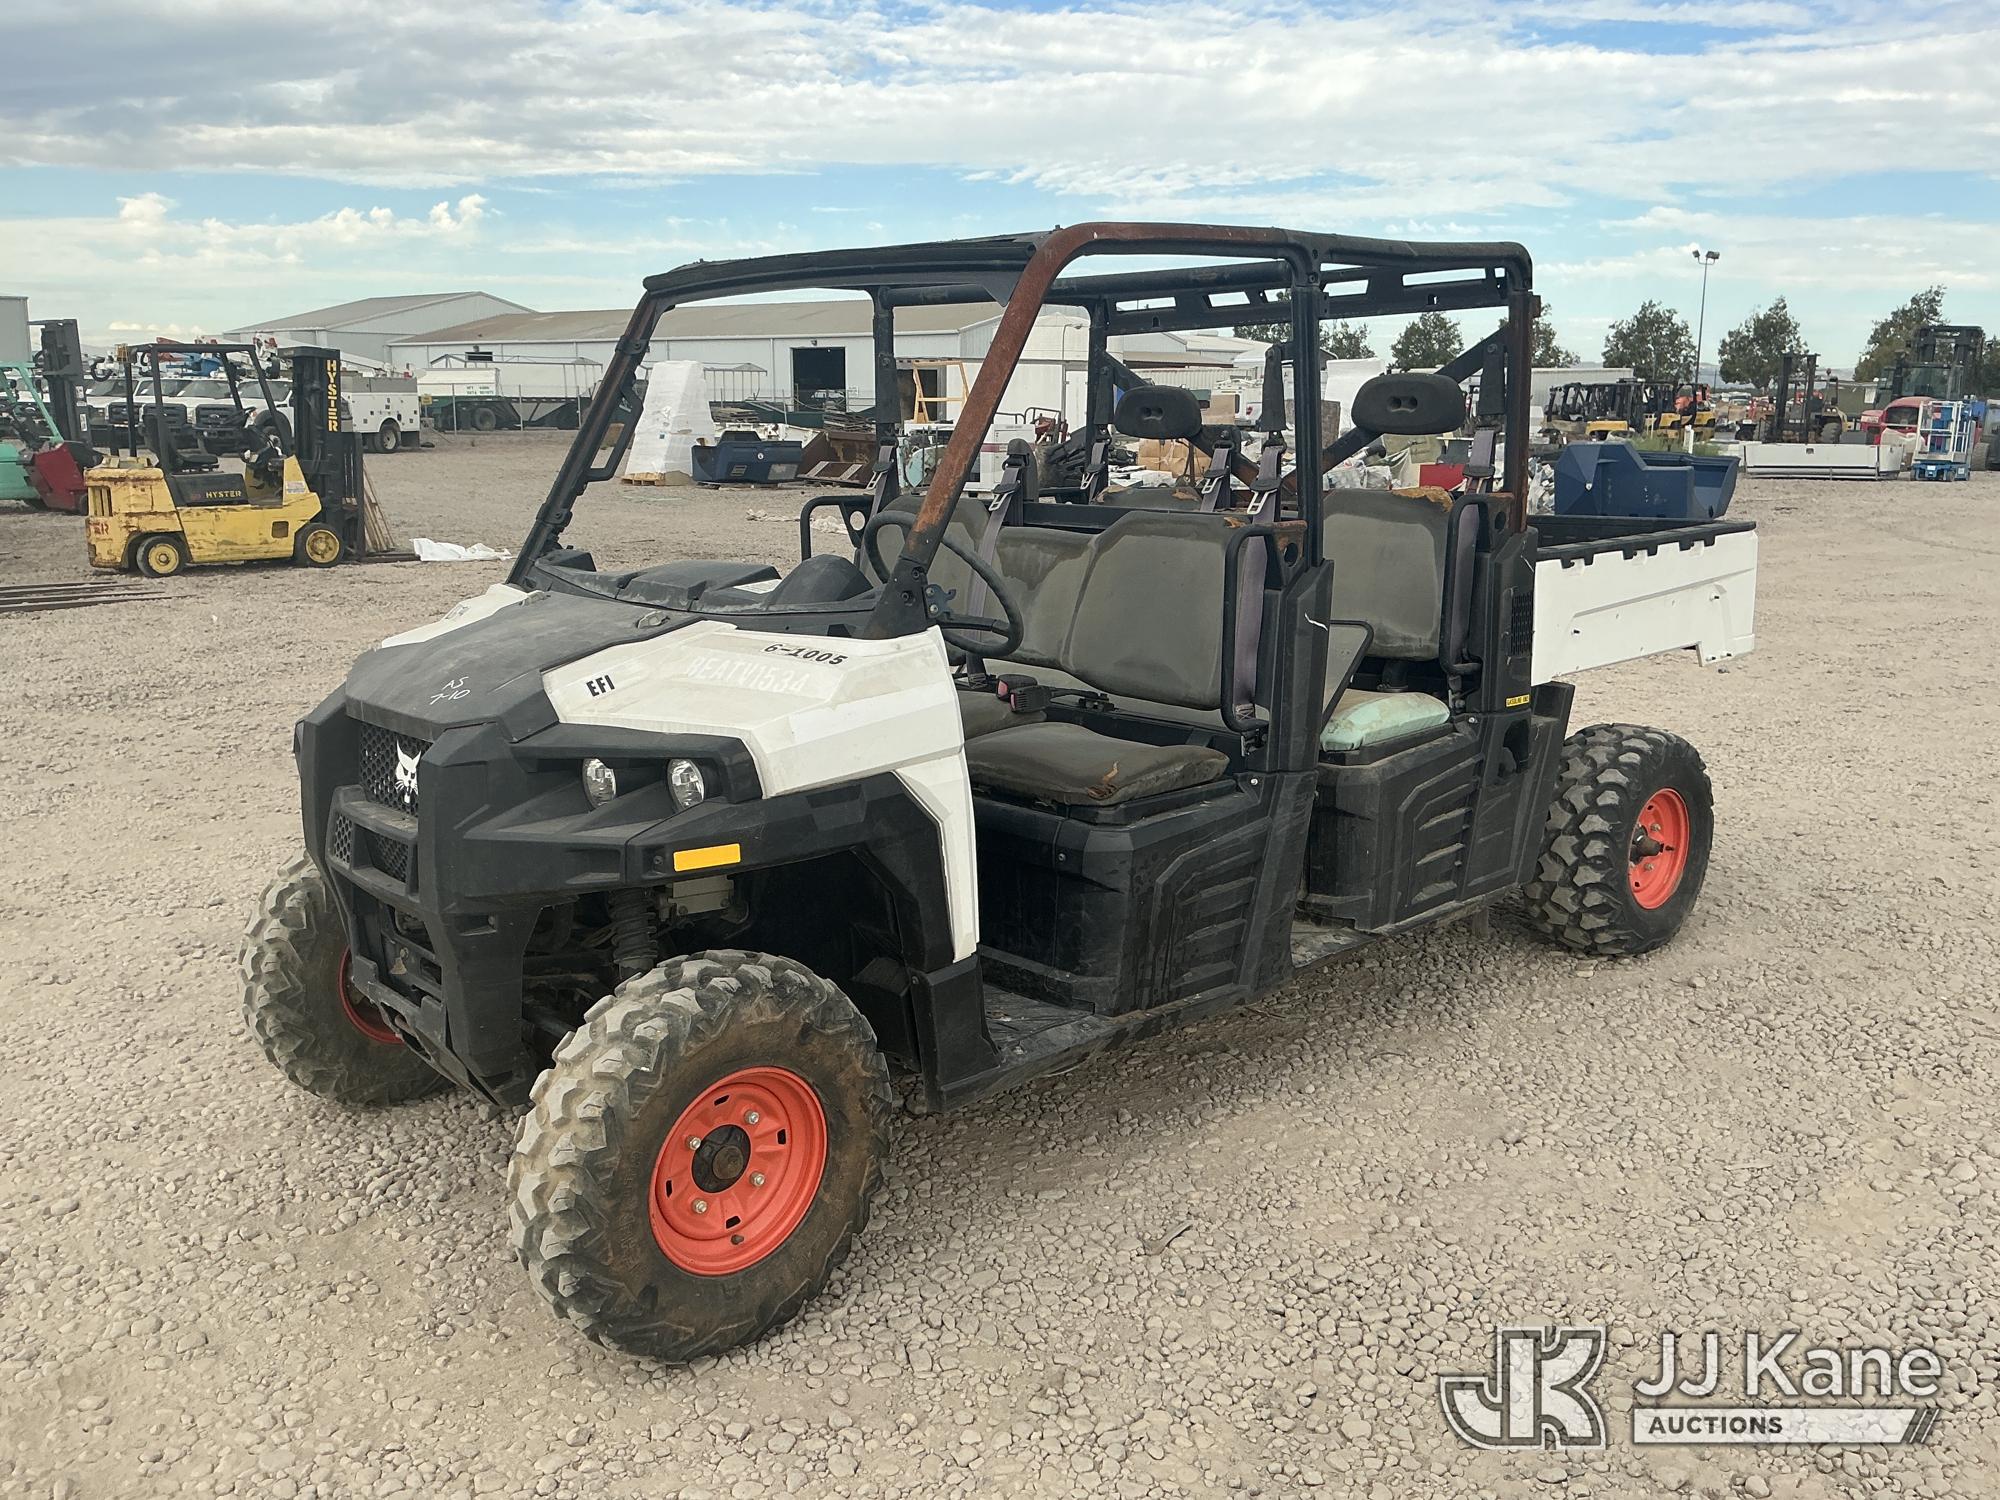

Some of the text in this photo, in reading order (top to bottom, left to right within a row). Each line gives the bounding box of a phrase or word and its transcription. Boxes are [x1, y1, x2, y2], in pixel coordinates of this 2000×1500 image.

[326, 359, 338, 432] HYSTER
[205, 490, 242, 499] HYSTER
[764, 643, 848, 665] 6-1005
[586, 674, 616, 697] EFI
